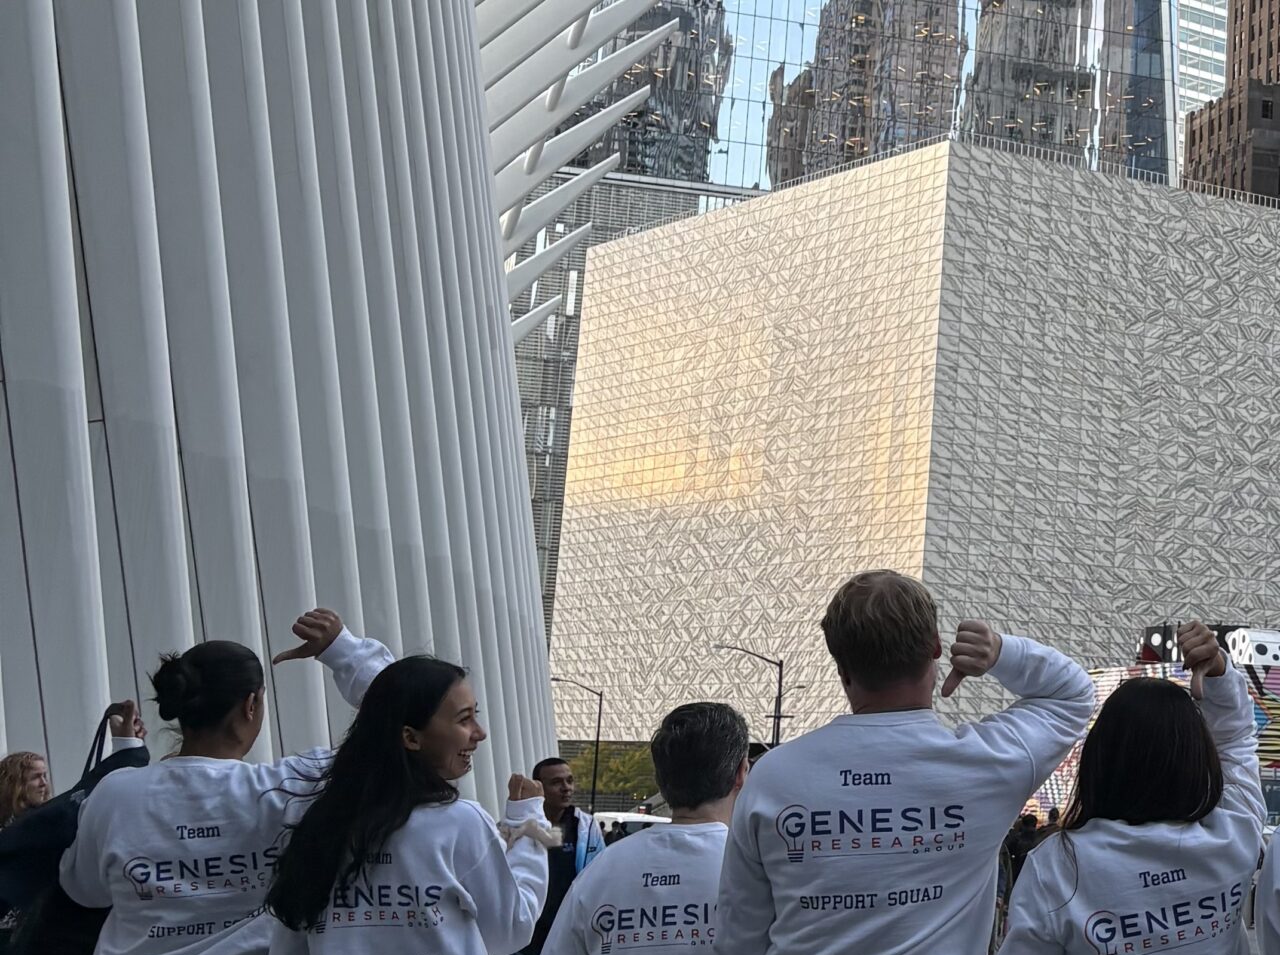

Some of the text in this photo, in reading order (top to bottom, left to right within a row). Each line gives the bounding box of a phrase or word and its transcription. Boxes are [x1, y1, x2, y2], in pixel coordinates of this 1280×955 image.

[840, 769, 892, 787] Team
[782, 804, 965, 838] GENESIS
[176, 825, 221, 840] Team
[812, 831, 965, 851] RESEARCH
[912, 843, 965, 854] GROUP
[129, 847, 280, 884] GENESIS
[156, 872, 265, 896] RESEARC
[641, 872, 681, 888] Team
[1139, 868, 1187, 888] Team
[332, 885, 443, 909] ENESIS
[800, 885, 943, 910] SUPPORT SQUAD
[596, 903, 718, 932] GENESI
[1092, 882, 1242, 943] GENESIS
[148, 921, 216, 938] SUPPORT
[617, 928, 715, 944] RESEARC
